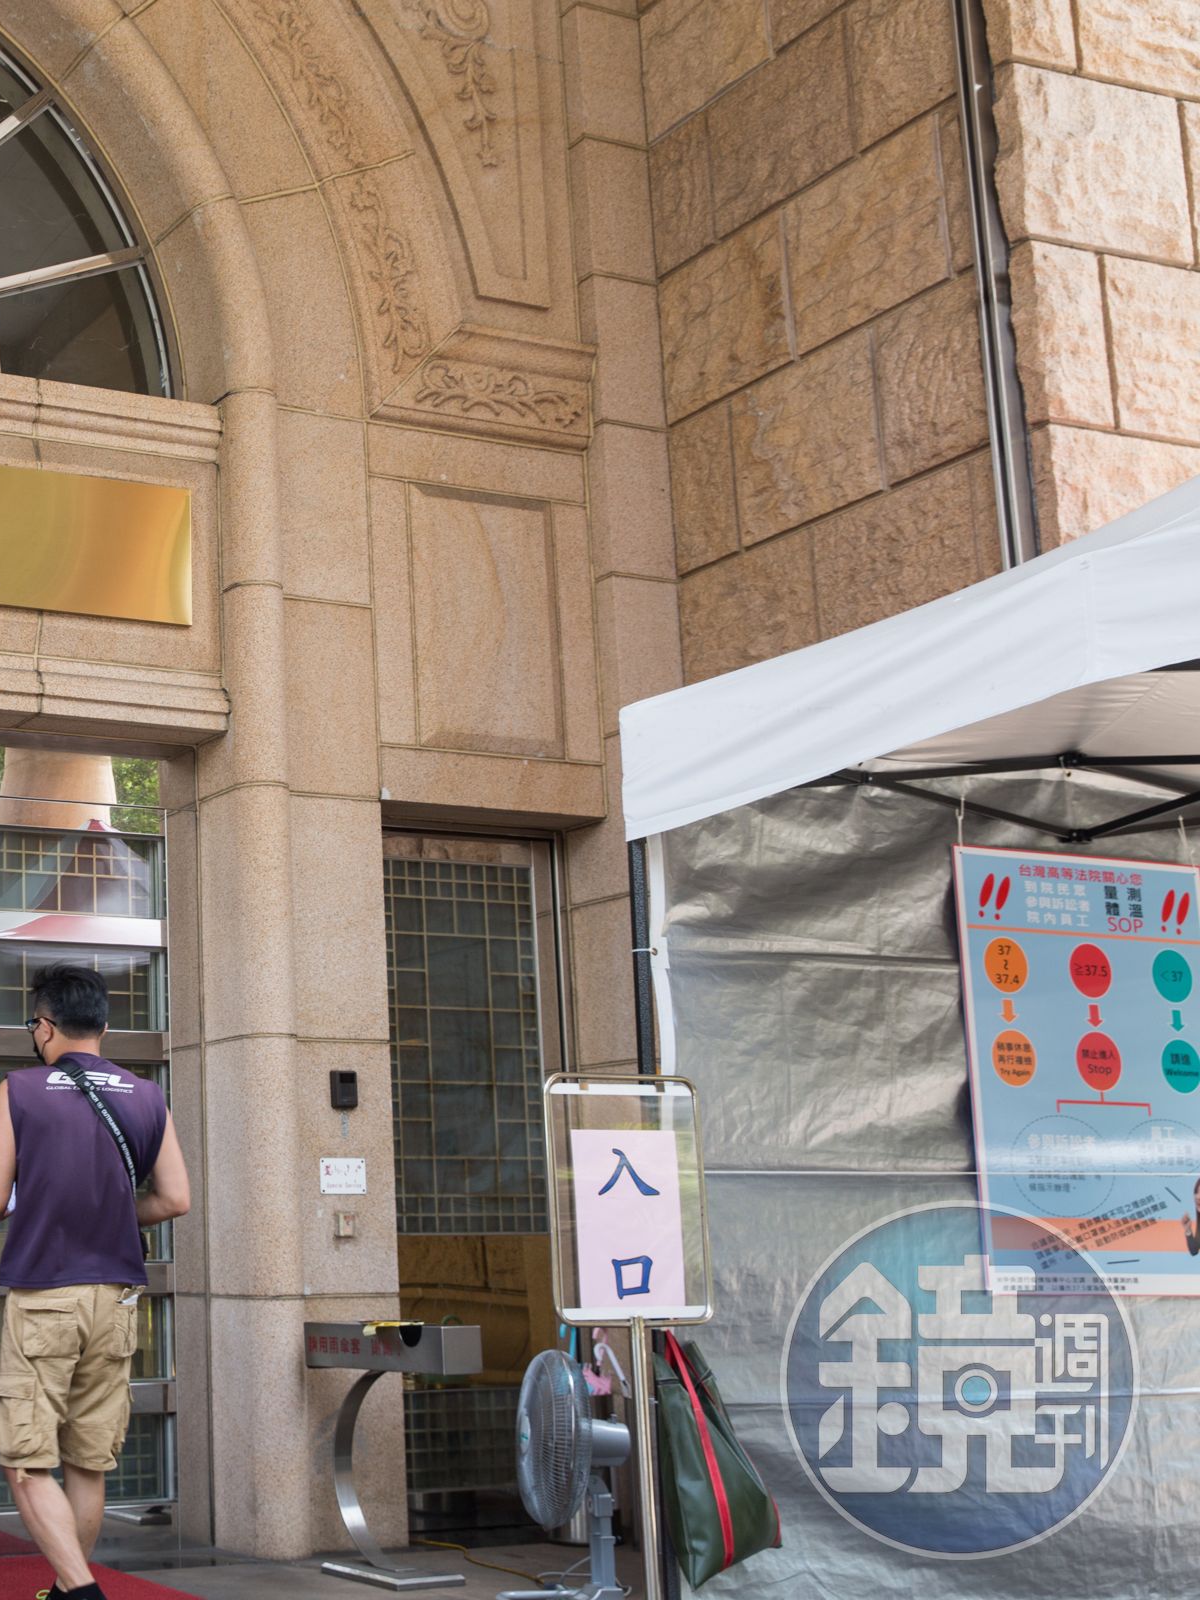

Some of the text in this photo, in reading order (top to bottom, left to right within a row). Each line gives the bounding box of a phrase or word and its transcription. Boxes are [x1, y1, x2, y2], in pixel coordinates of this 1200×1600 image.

[1107, 916, 1144, 934] SOP
[997, 945, 1012, 956] 37
[995, 973, 1020, 985] 37.4
[1088, 1064, 1112, 1076] Stop
[101, 1087, 134, 1095] LOGISTICS
[597, 1147, 661, 1301] 入口
